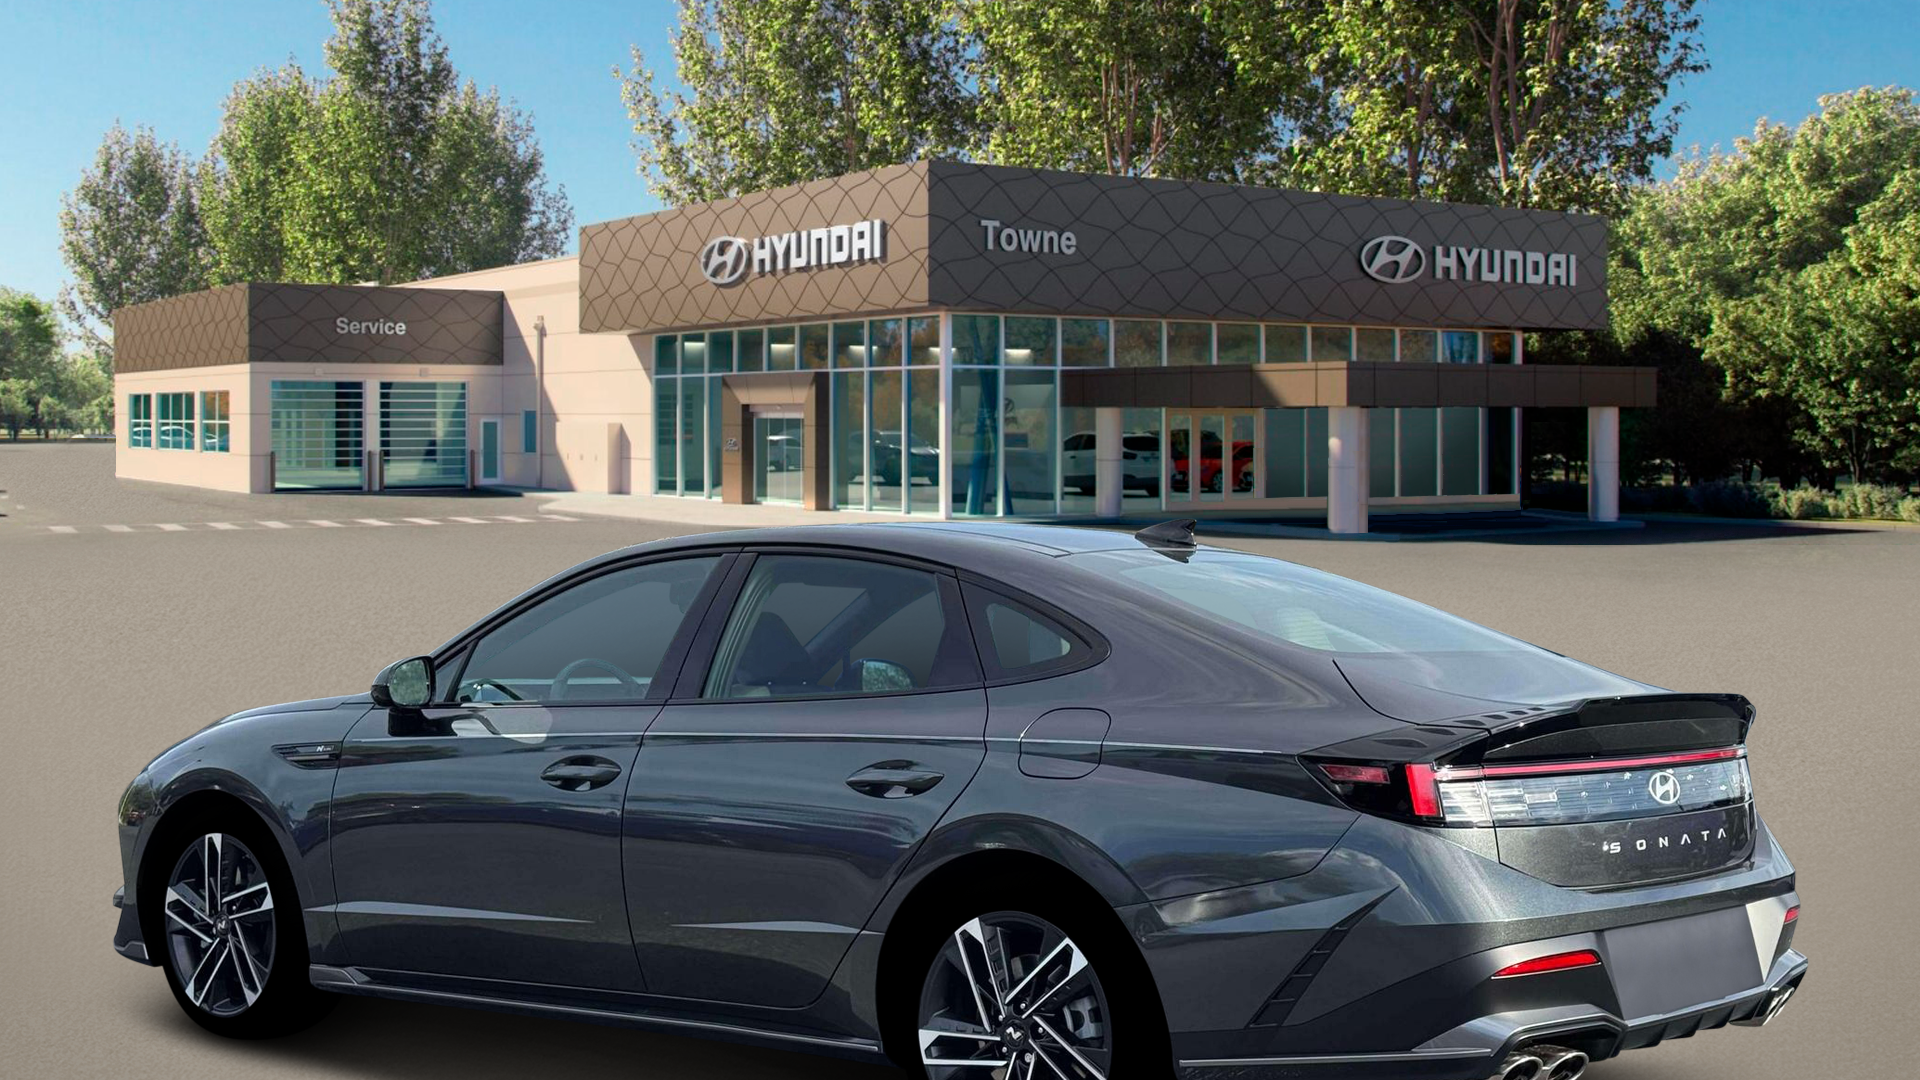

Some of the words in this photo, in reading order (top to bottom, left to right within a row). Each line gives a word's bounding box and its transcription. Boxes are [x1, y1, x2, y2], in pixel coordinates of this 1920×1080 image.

[753, 219, 882, 273] HYUNDAI
[980, 220, 1077, 255] Towne
[1435, 245, 1577, 286] HYUNDAI
[336, 317, 406, 335] Service
[1609, 828, 1727, 854] SONATA
